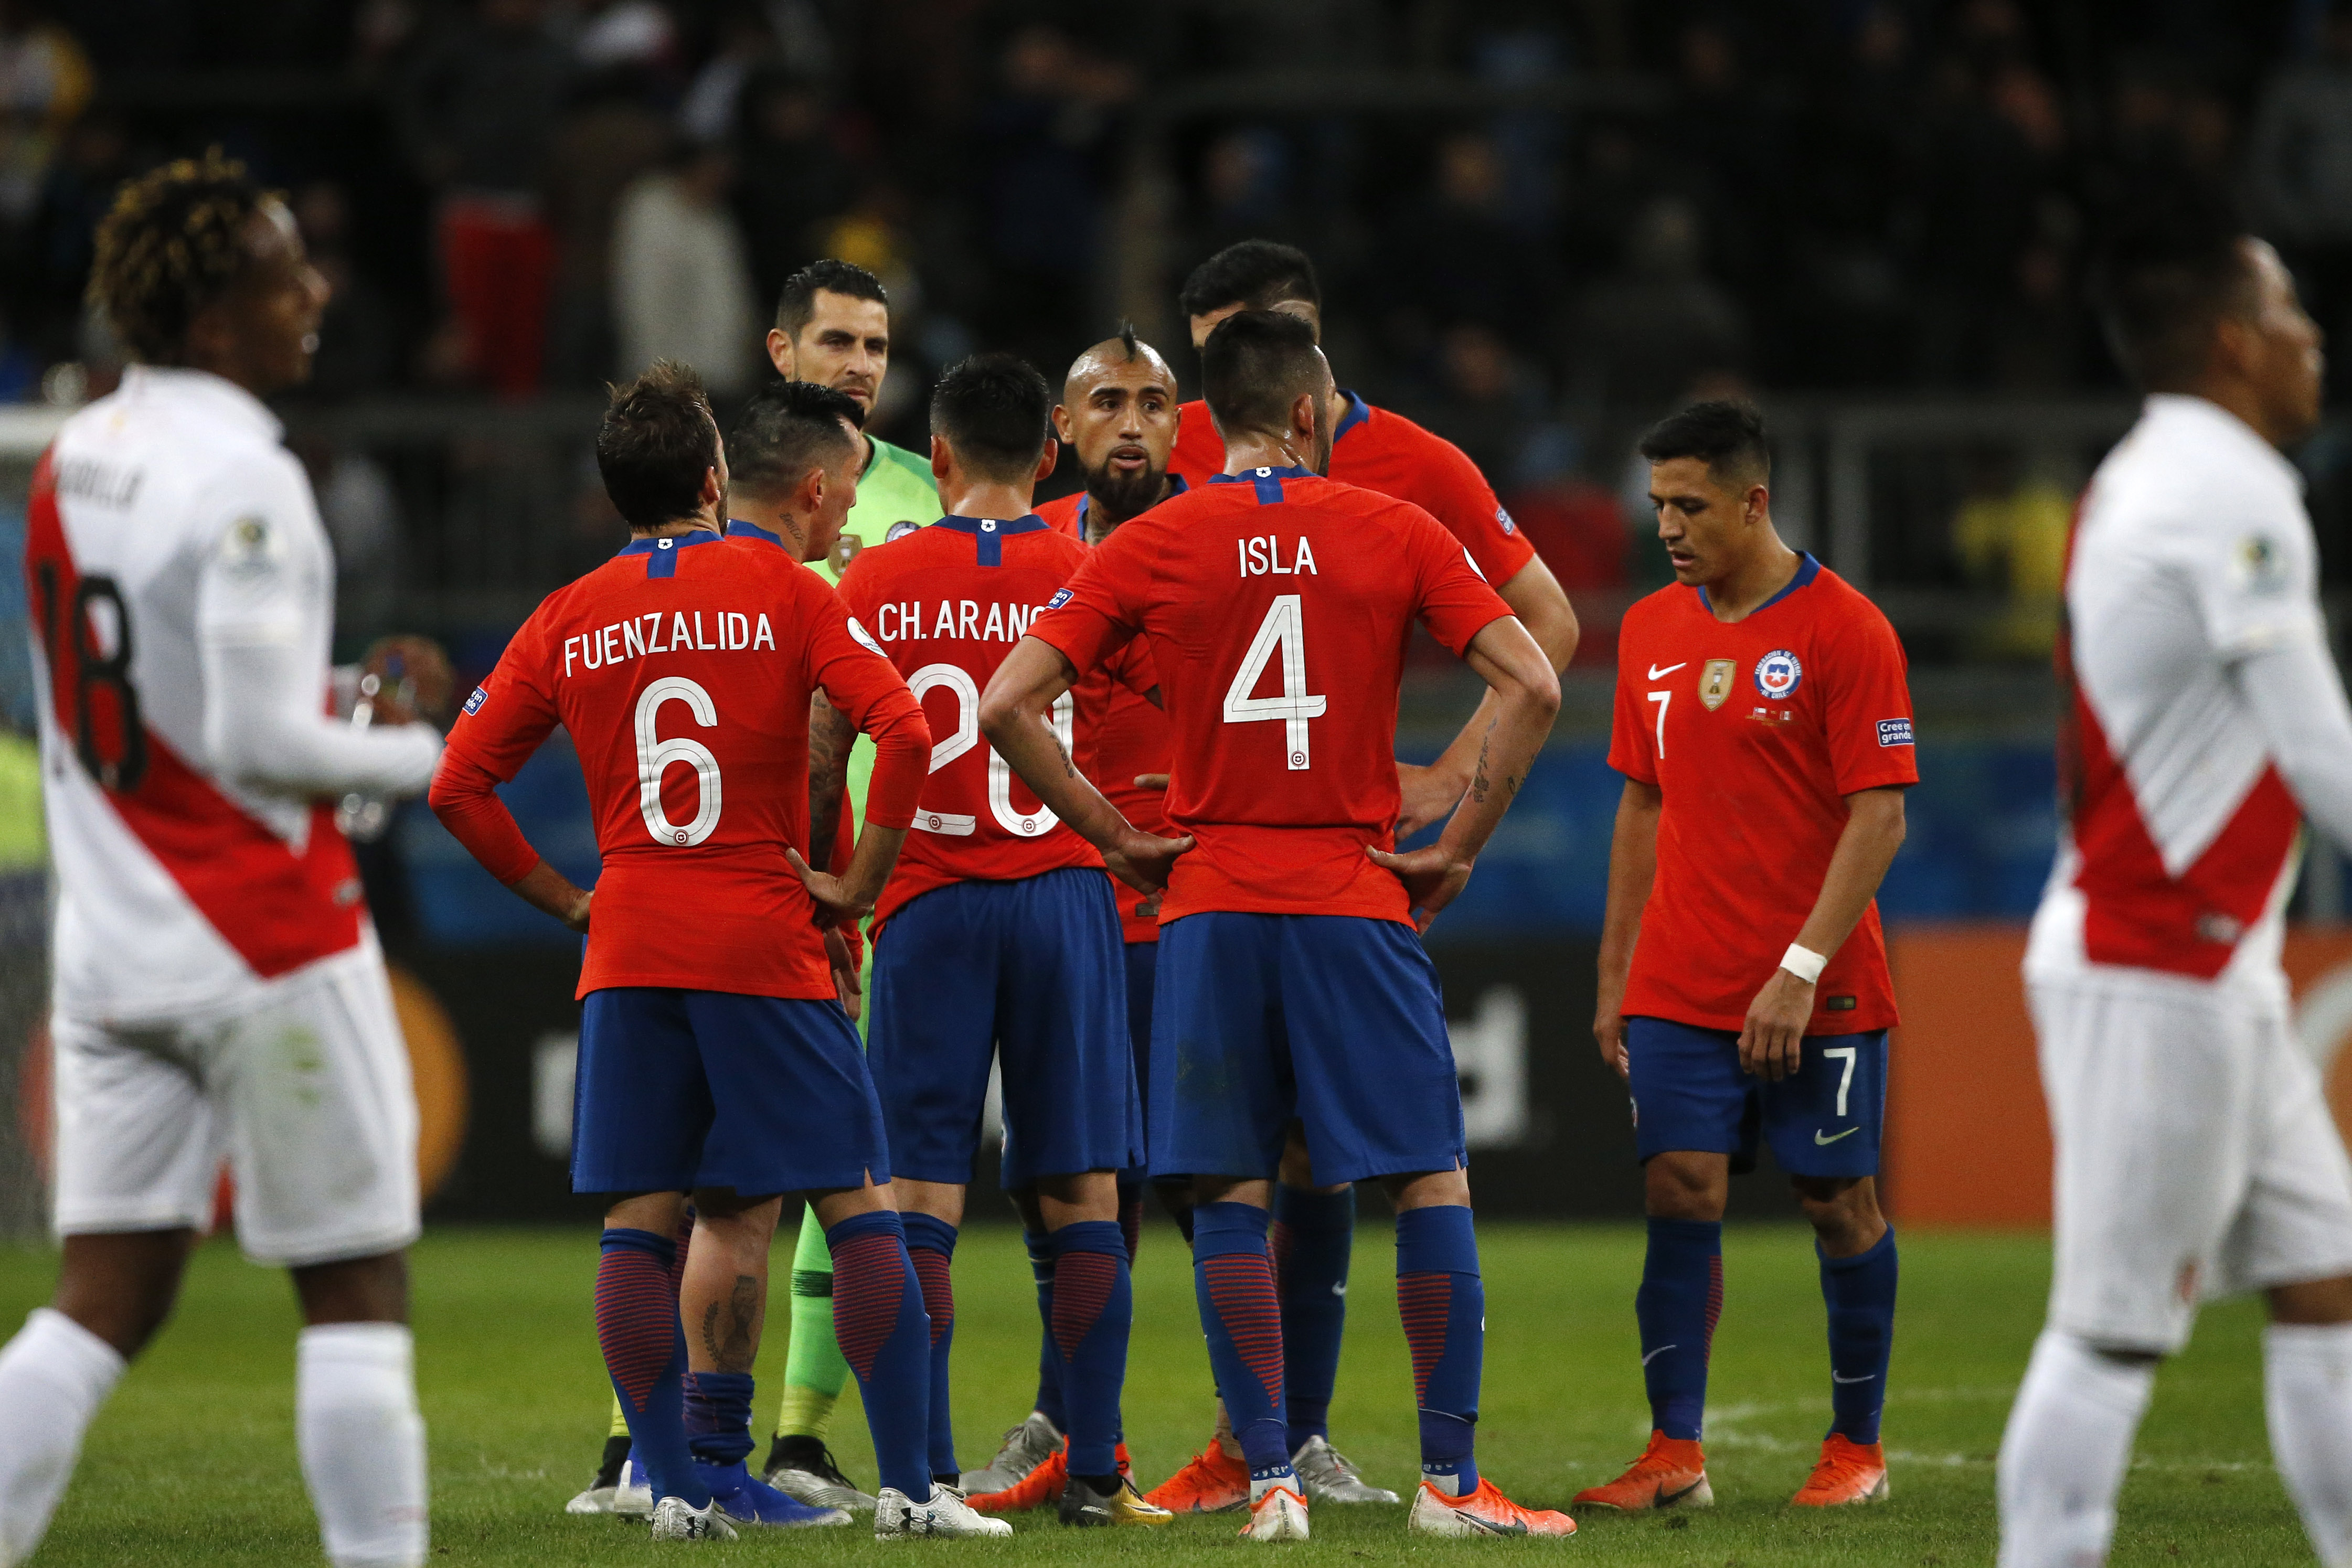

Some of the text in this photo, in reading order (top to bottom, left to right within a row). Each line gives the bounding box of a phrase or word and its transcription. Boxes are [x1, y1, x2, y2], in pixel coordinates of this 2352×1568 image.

[1238, 535, 1317, 578] ISLA
[40, 560, 148, 791] 18
[564, 611, 775, 678] FUENZALIDA
[1223, 594, 1326, 770] 4
[905, 663, 1073, 837] 20
[1647, 691, 1672, 759] 7
[1879, 723, 1903, 732] Cree
[1881, 731, 1912, 743] grande
[634, 676, 722, 847] 6
[1823, 1047, 1856, 1117] 7
